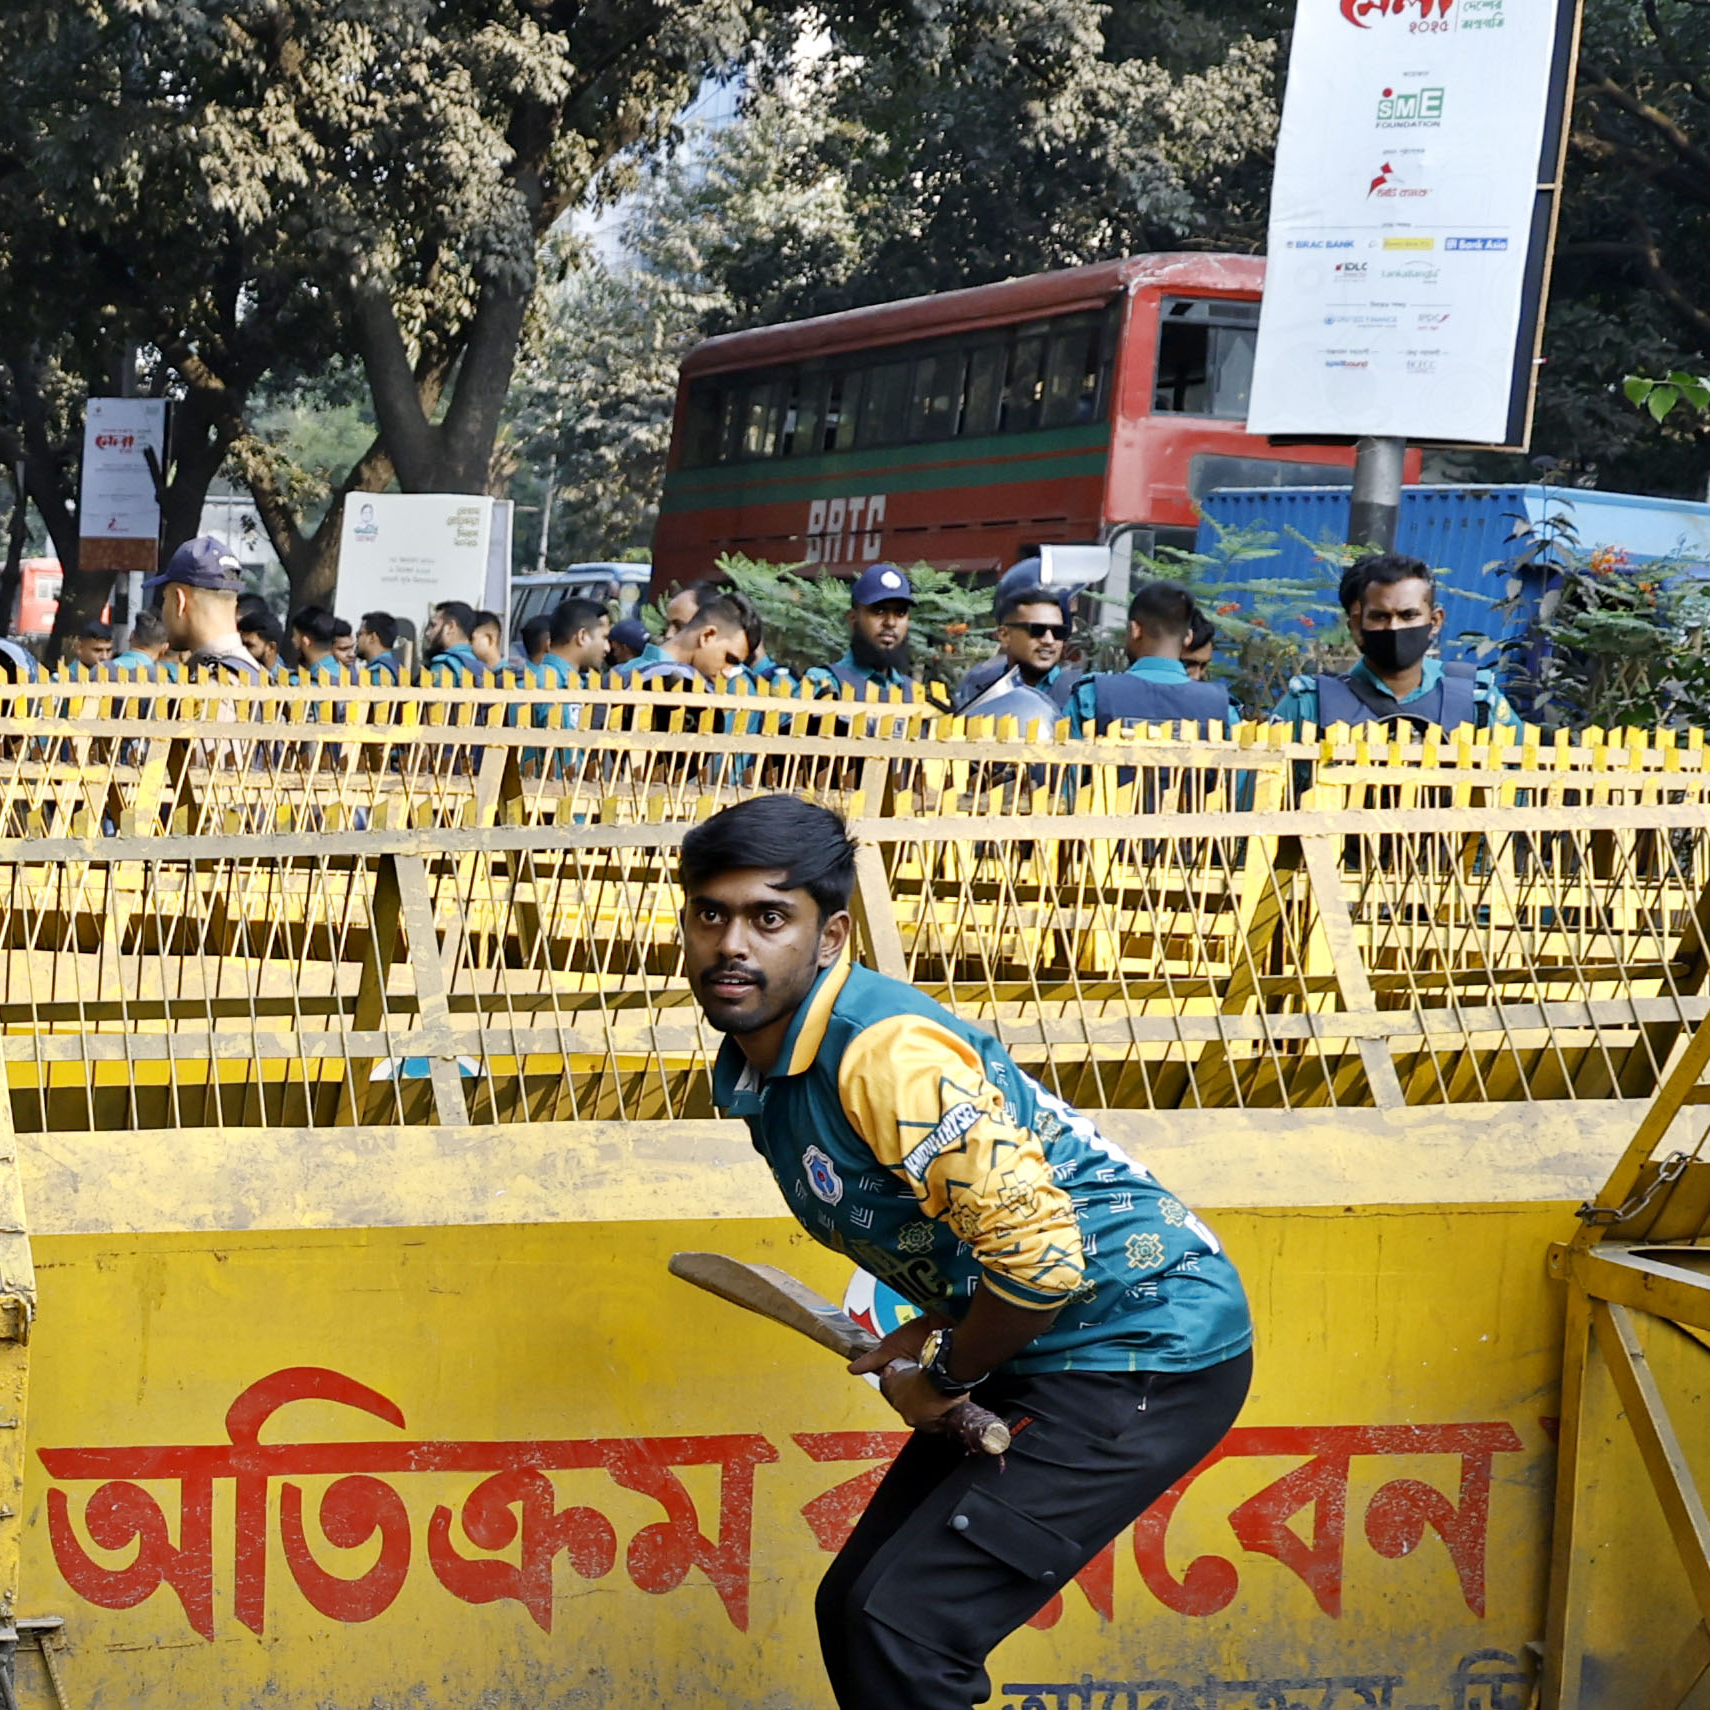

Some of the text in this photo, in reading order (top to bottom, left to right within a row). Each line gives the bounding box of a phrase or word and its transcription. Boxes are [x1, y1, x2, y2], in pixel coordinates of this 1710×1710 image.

[1408, 20, 1449, 35] ২০২৫
[1377, 87, 1445, 120] SME
[1375, 120, 1441, 129] FOUNDATION
[1325, 239, 1354, 249] BANK
[1458, 237, 1483, 249] Bank
[804, 494, 887, 562] BRTC
[36, 1366, 780, 1643] অতিক্রম
